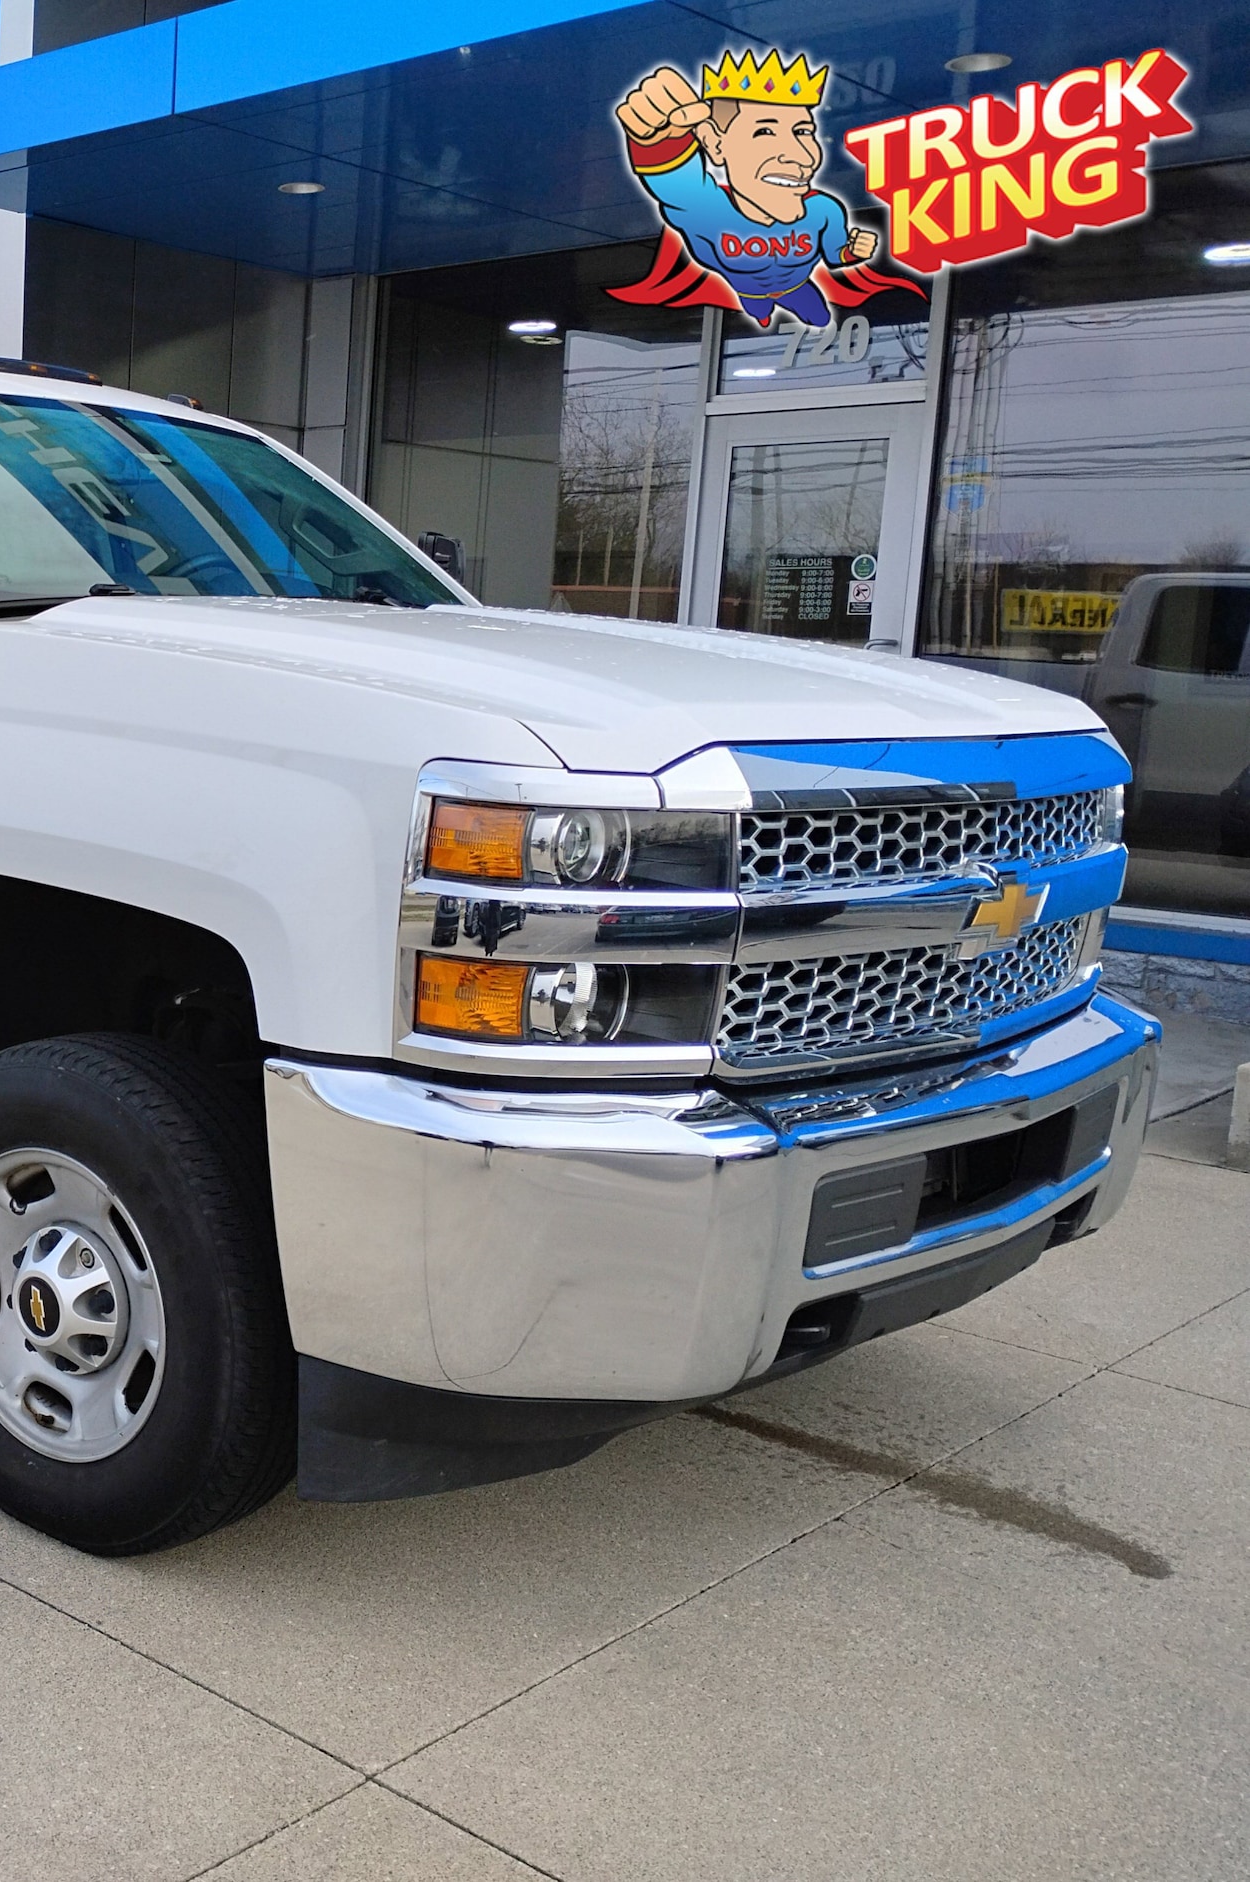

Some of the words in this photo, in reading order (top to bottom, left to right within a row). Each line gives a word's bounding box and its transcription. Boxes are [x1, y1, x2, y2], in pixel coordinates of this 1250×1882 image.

[778, 315, 870, 368] 720
[769, 559, 798, 567] SALES
[800, 558, 833, 566] HOURS
